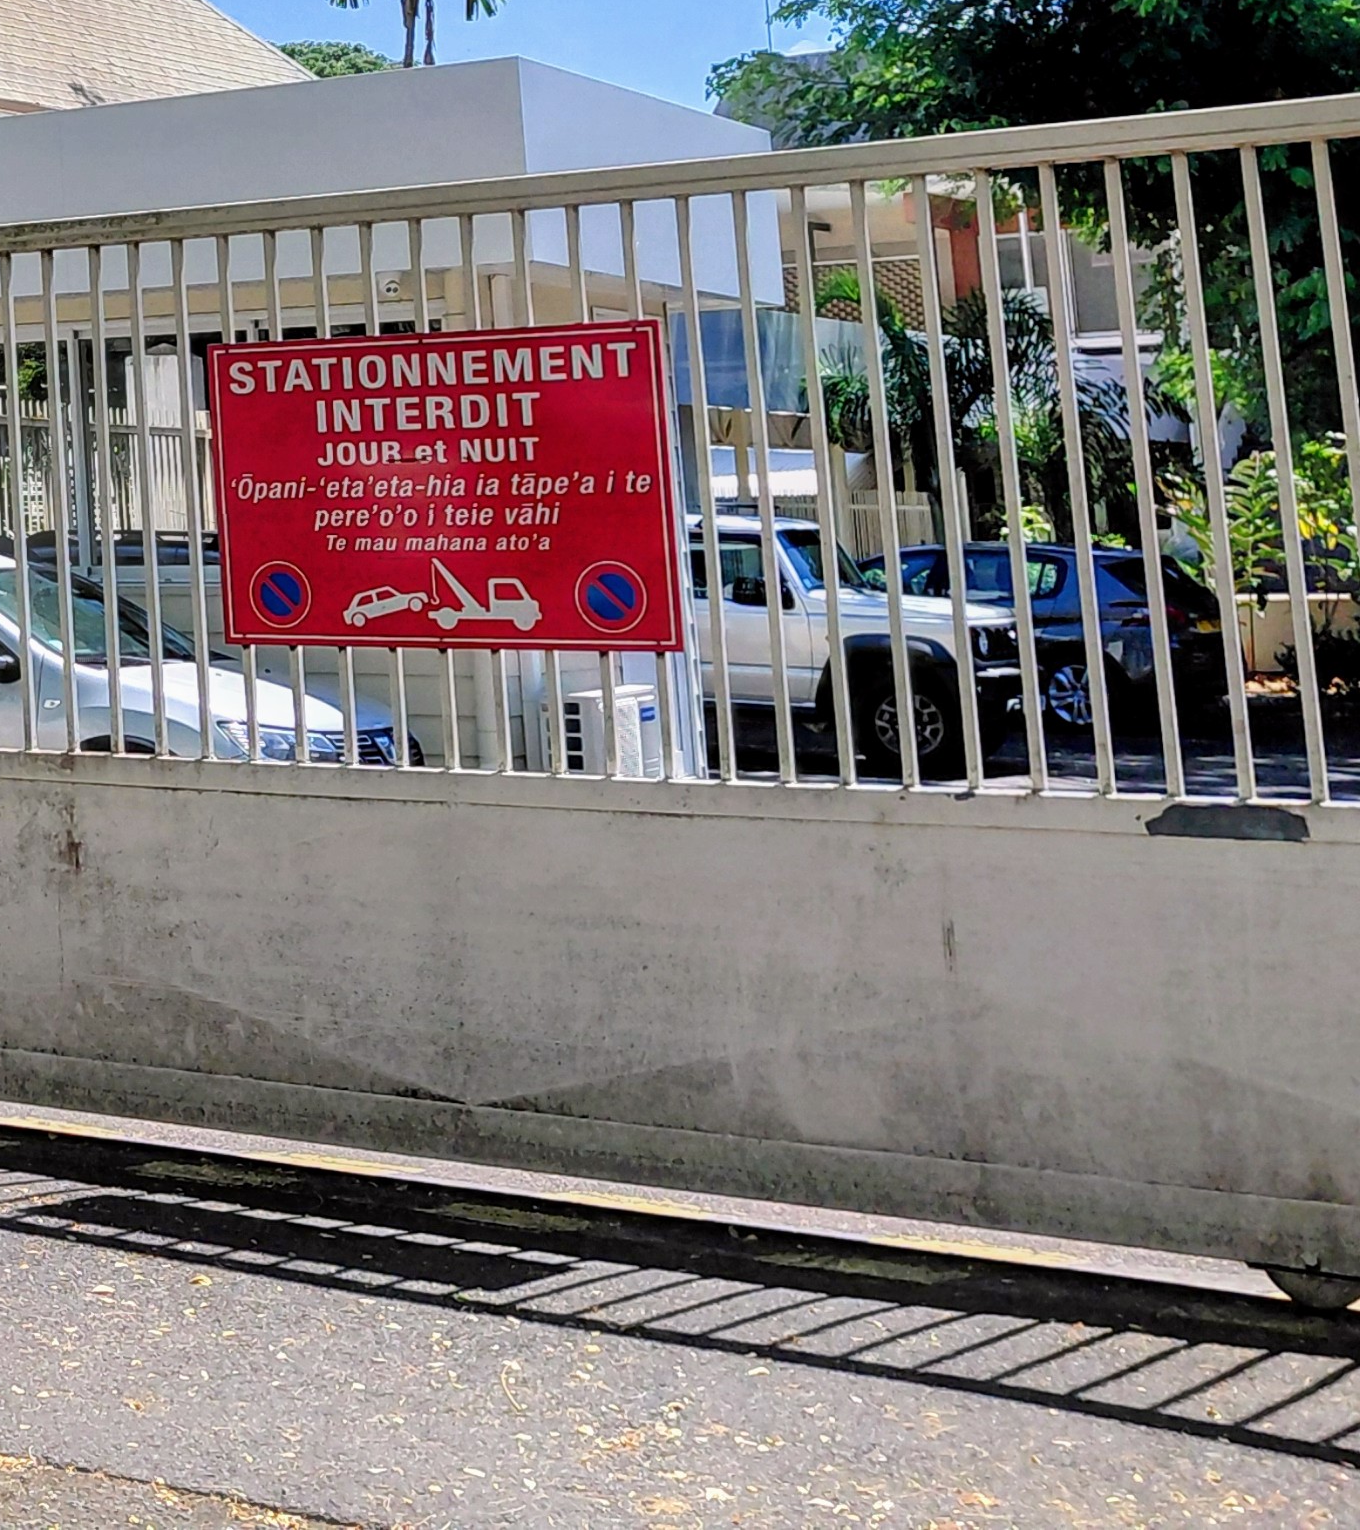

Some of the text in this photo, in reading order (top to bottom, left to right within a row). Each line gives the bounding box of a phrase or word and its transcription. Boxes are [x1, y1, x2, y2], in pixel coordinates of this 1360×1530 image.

[229, 342, 637, 395] STATIONNEMENT
[316, 392, 541, 433] INTERDIT
[317, 437, 539, 467] JOUR et NUIT
[476, 473, 500, 496] ia
[606, 470, 615, 493] i
[625, 470, 652, 493] te
[314, 501, 560, 531] pere’o’o i teie vāhi
[326, 533, 550, 551] Te mau mahana ato’a
